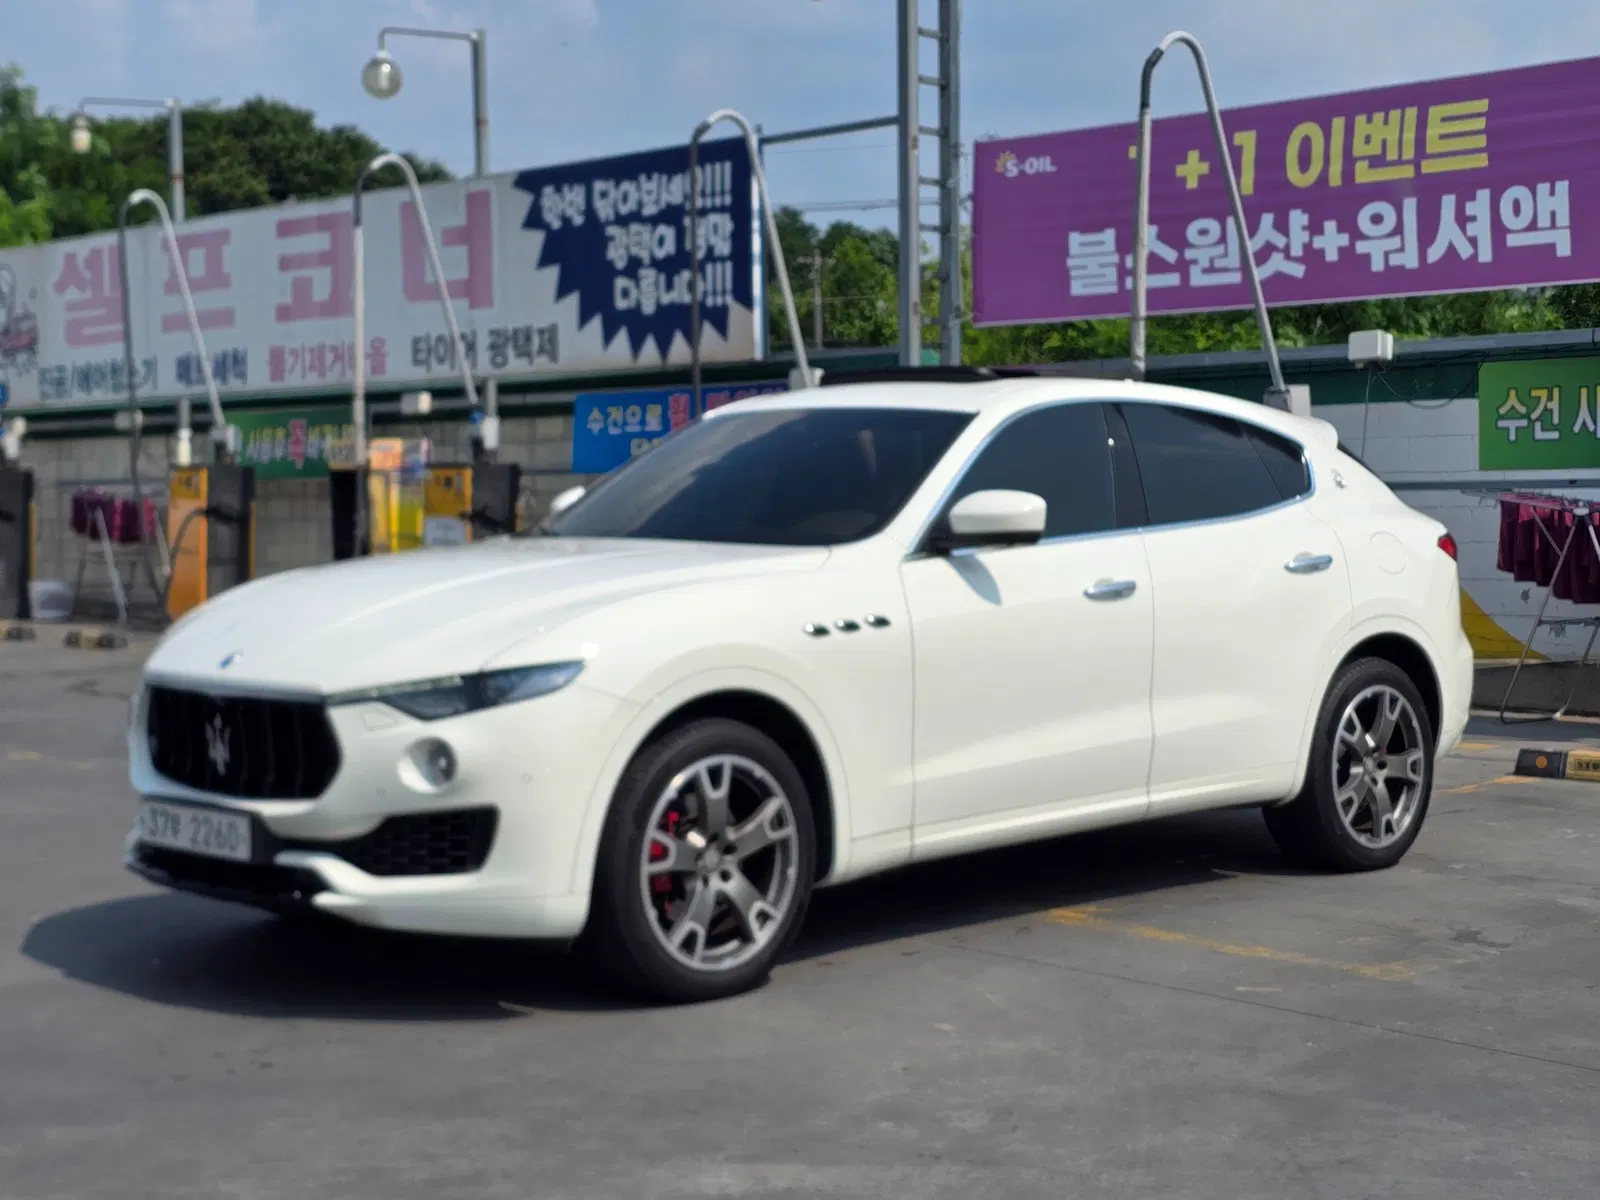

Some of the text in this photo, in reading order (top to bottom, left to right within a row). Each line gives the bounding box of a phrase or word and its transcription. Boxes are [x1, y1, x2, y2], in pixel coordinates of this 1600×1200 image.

[1004, 156, 1057, 178] S-OIL
[1286, 98, 1489, 188] 이벤트
[1066, 179, 1572, 297] 불스원샷+워셔액
[411, 328, 478, 373] 타이어
[486, 322, 560, 370] 광택제
[586, 403, 663, 436] 수건으로
[1496, 384, 1561, 443] 수건
